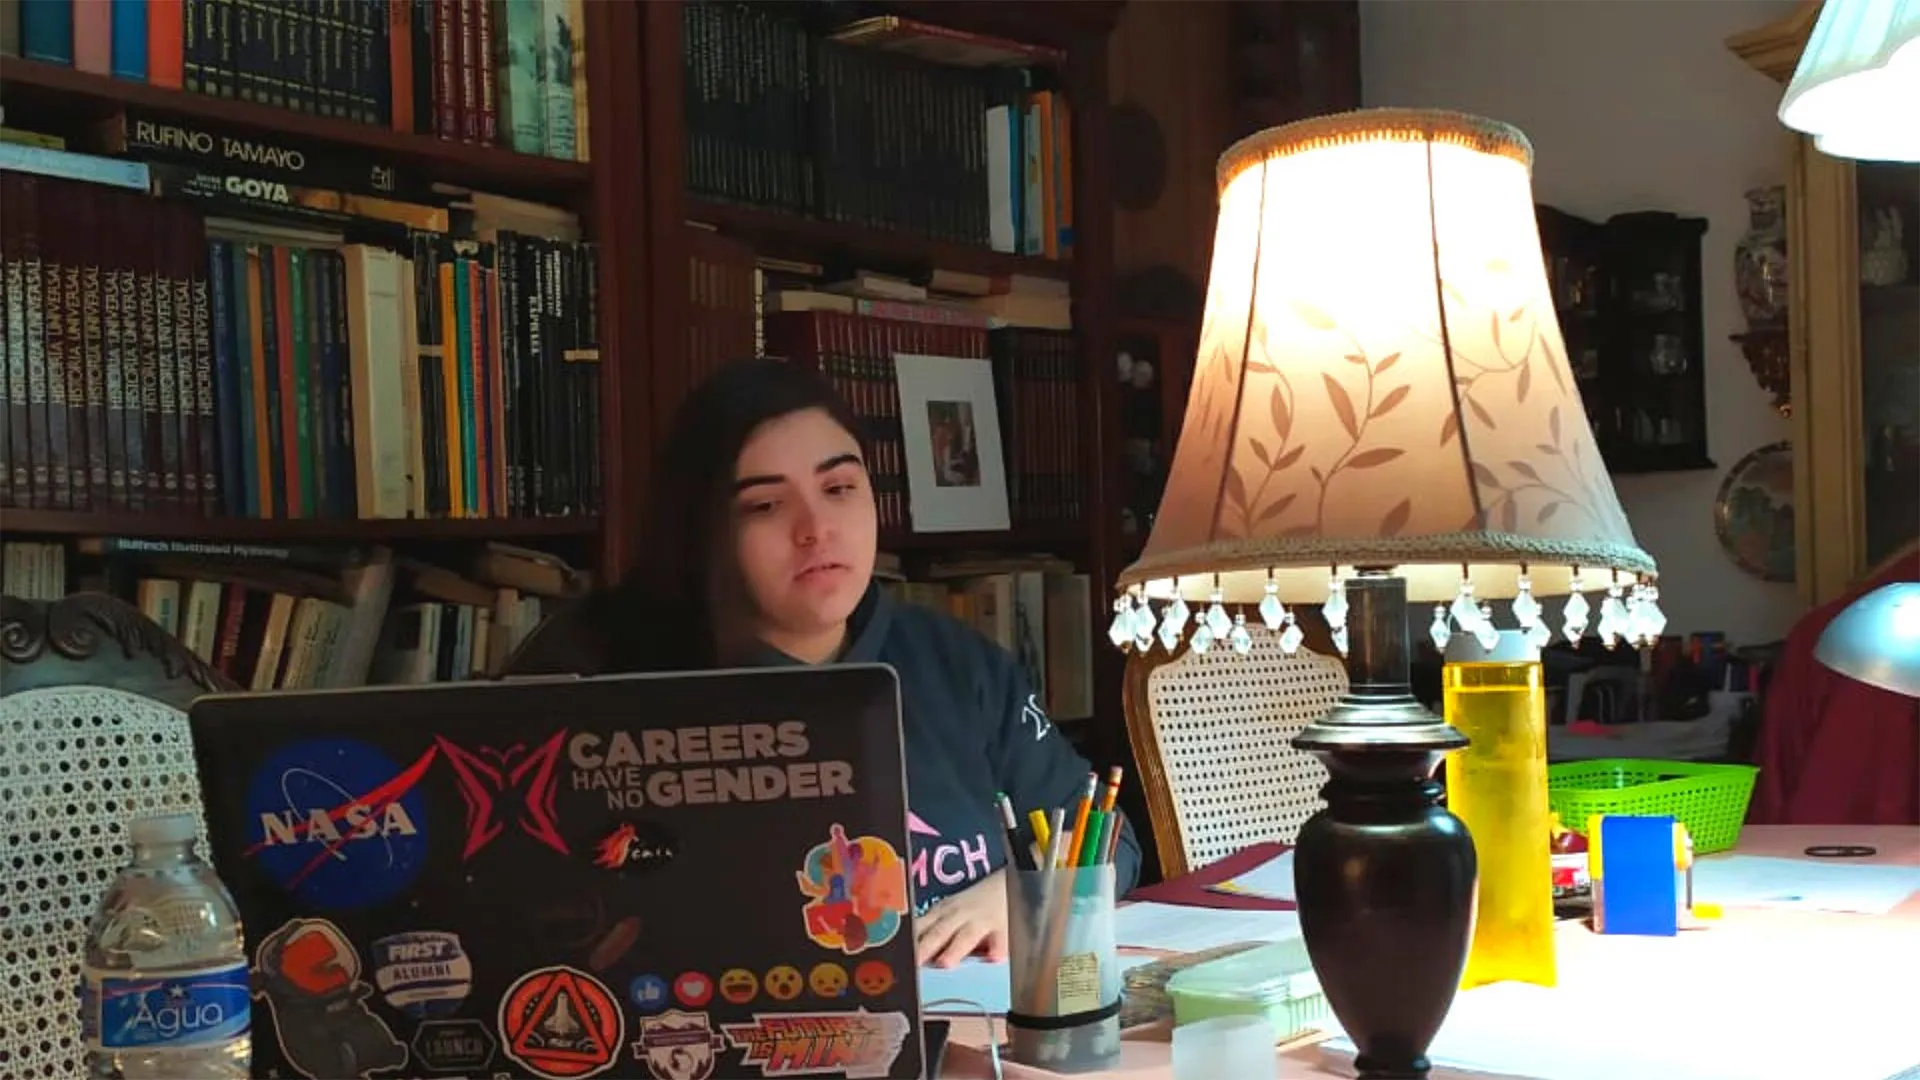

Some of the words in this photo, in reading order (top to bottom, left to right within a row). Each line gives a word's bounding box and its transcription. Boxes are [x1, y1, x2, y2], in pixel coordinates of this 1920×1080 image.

[136, 120, 213, 154] RUFINO
[222, 136, 305, 171] TAMAYO
[225, 175, 289, 203] GOYA
[8, 259, 23, 336] UNIVERSAL
[25, 257, 43, 336] UNIVERSAL
[45, 262, 62, 336] UNIVERSAL
[65, 264, 81, 341] UNIVERSAL
[83, 264, 100, 339] UNIVERSAL
[104, 270, 120, 344] UNIVERSAL
[121, 267, 137, 343] UNIVERSAL
[140, 273, 155, 346] UNIVERSAL
[156, 275, 173, 349] UNIVERSAL
[175, 279, 191, 351] UNIVERSAL
[193, 279, 210, 352] UNIVERSAL
[10, 340, 27, 405] HISTORIA
[28, 342, 45, 404] HISTORIA
[48, 341, 65, 404] HISTORIA
[67, 346, 85, 407] HISTORIA
[86, 344, 104, 406] HISTORIA
[107, 347, 123, 410] HISTORIA
[124, 347, 140, 409] HISTORIA
[143, 350, 158, 413] HISTORIA
[159, 352, 176, 414] HISTORIA
[178, 354, 195, 415] HISTORIA
[197, 355, 214, 416] HISTORIA
[568, 720, 810, 769] CAREERS
[571, 767, 641, 791] HAVE
[607, 789, 644, 811] NO
[646, 760, 856, 808] GENDER
[261, 802, 417, 847] NASA
[388, 941, 449, 962] FIRST
[393, 963, 451, 981] ALUMNI
[135, 998, 223, 1038] Agua
